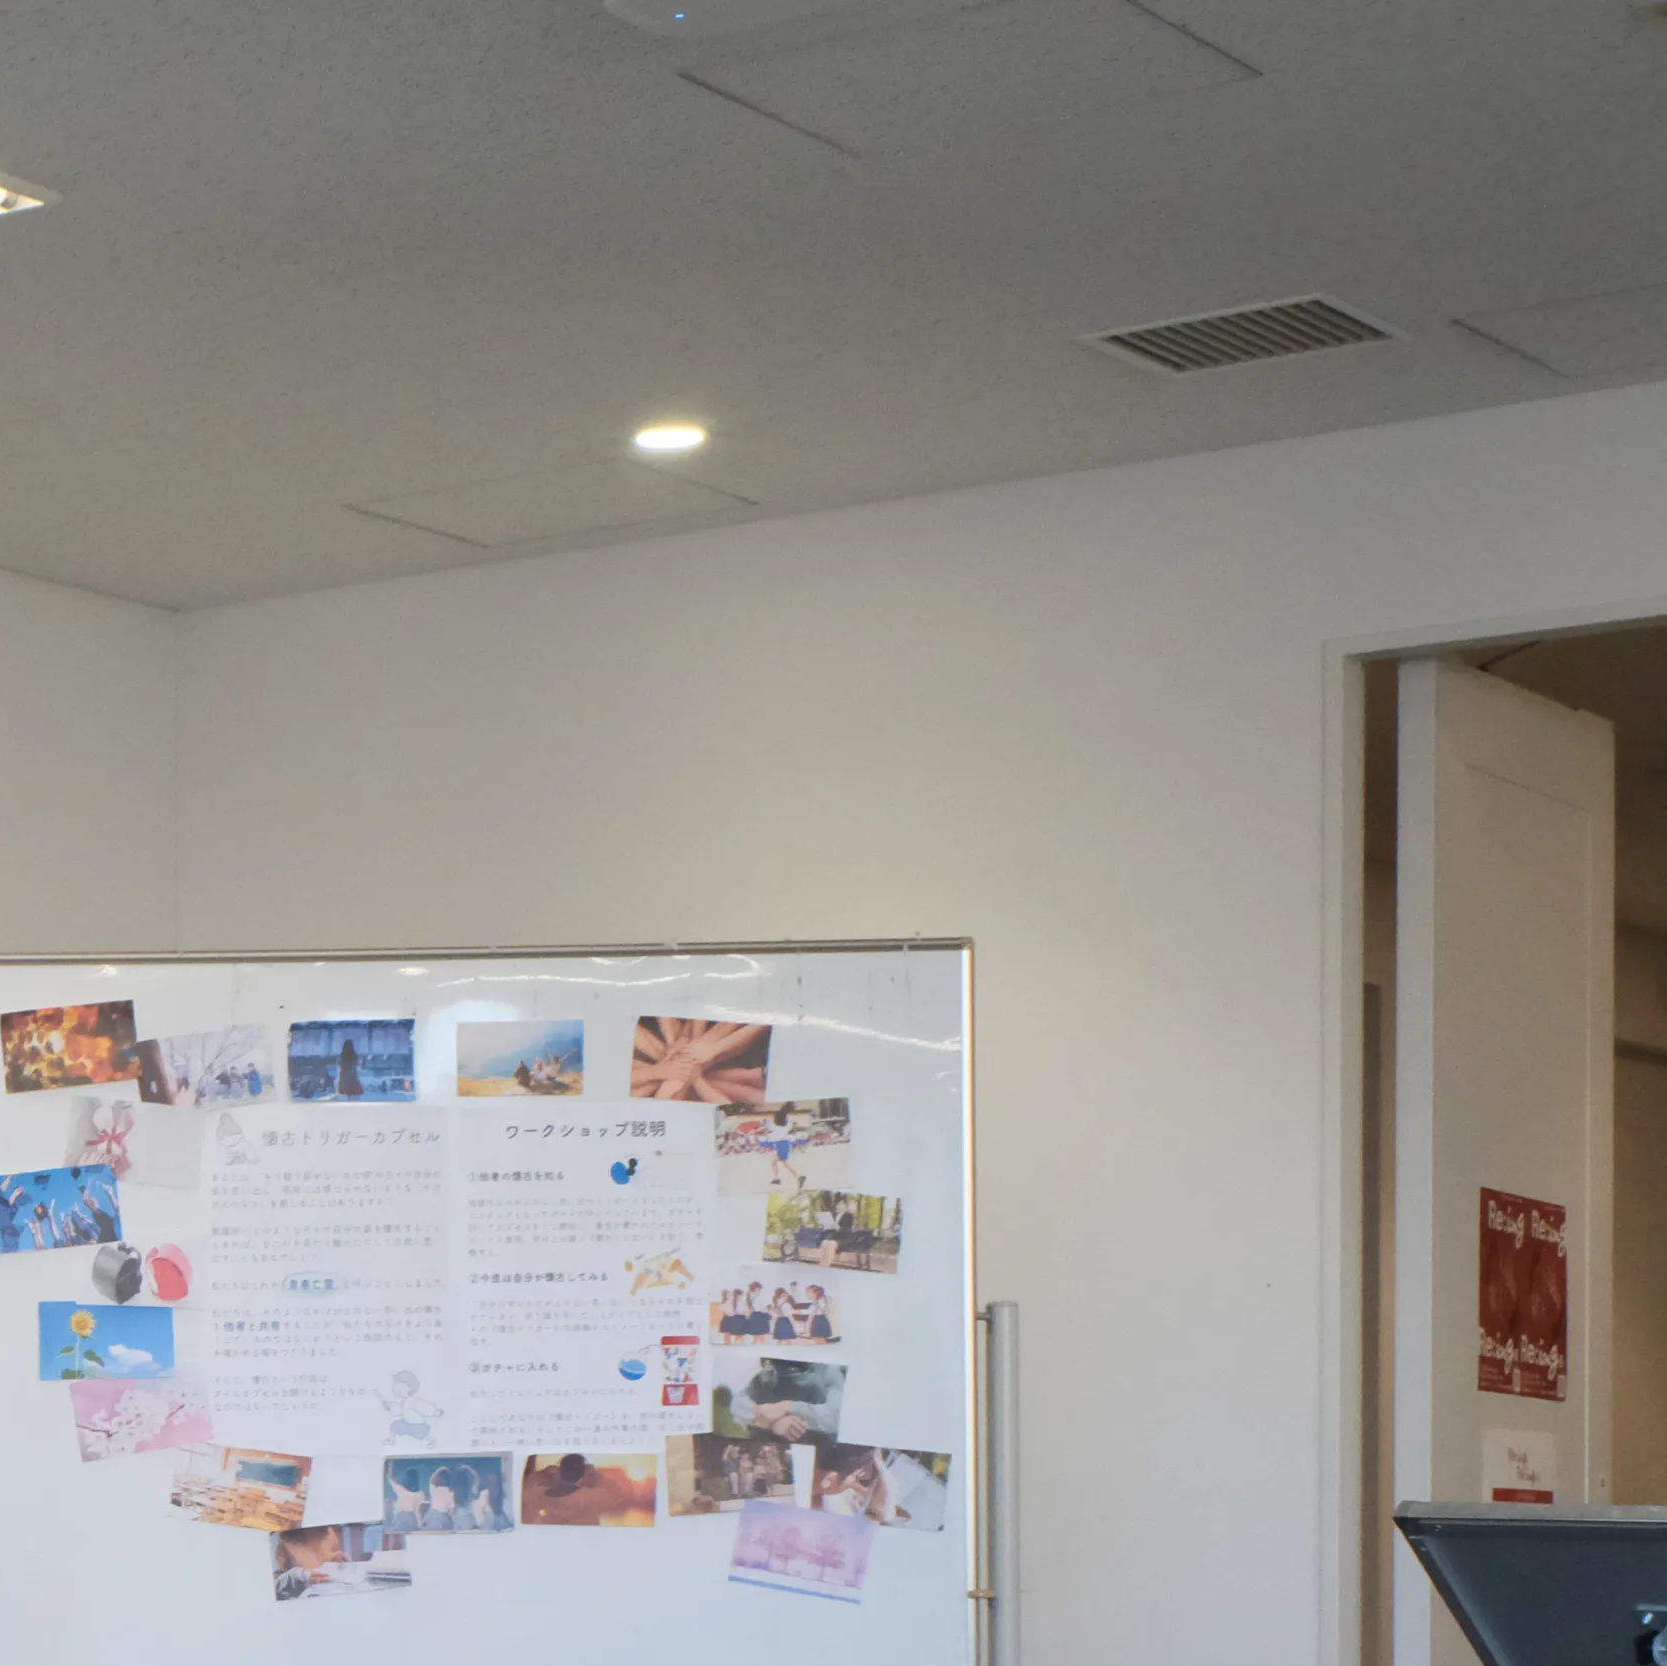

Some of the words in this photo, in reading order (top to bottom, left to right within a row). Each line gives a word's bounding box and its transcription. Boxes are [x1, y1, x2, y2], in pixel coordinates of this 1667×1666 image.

[505, 1120, 667, 1140] ワークショップ説明
